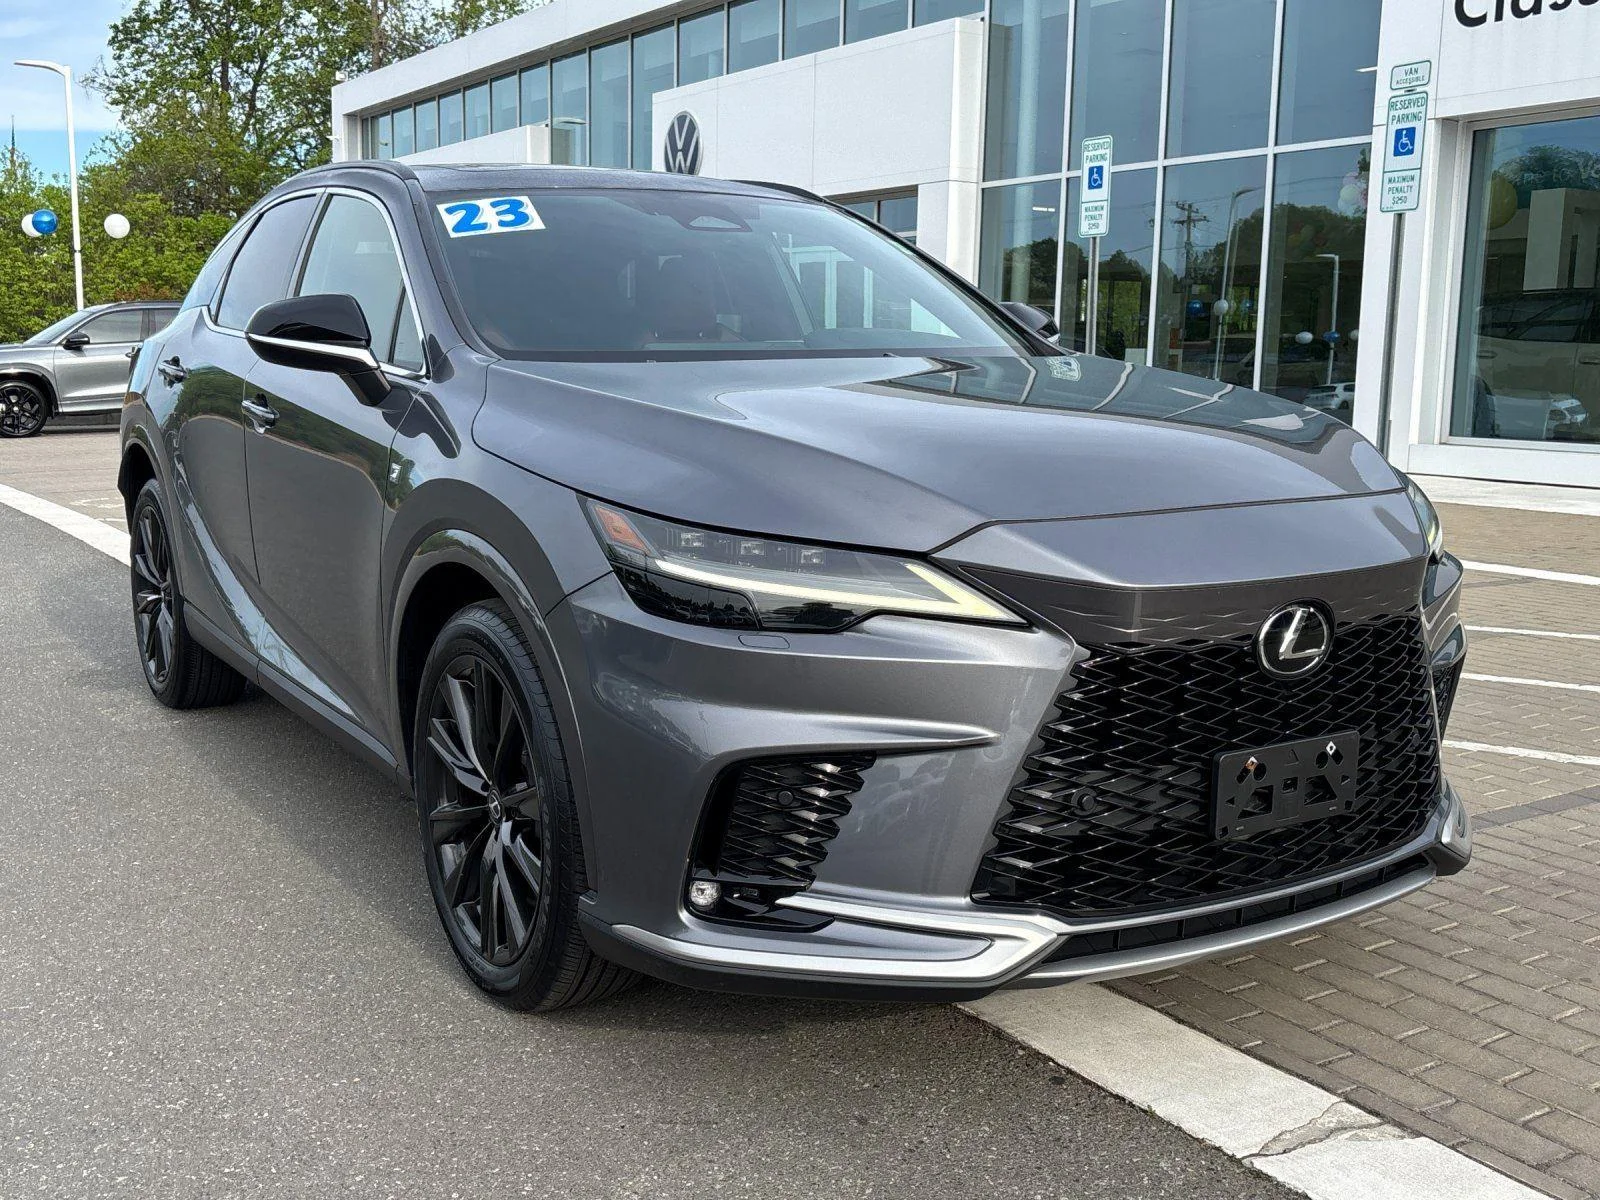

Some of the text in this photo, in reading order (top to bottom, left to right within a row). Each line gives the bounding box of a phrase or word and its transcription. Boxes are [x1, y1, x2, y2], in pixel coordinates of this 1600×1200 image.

[1404, 67, 1419, 76] VAN
[1396, 75, 1425, 85] ACCESSIBLE
[1390, 96, 1426, 111] RESERVED
[1391, 112, 1423, 125] PARKING
[1086, 153, 1107, 163] PARKING
[1388, 175, 1415, 184] MAXIMUM
[1388, 185, 1413, 195] PENALTY
[1392, 196, 1408, 205] $250
[444, 198, 531, 233] 23
